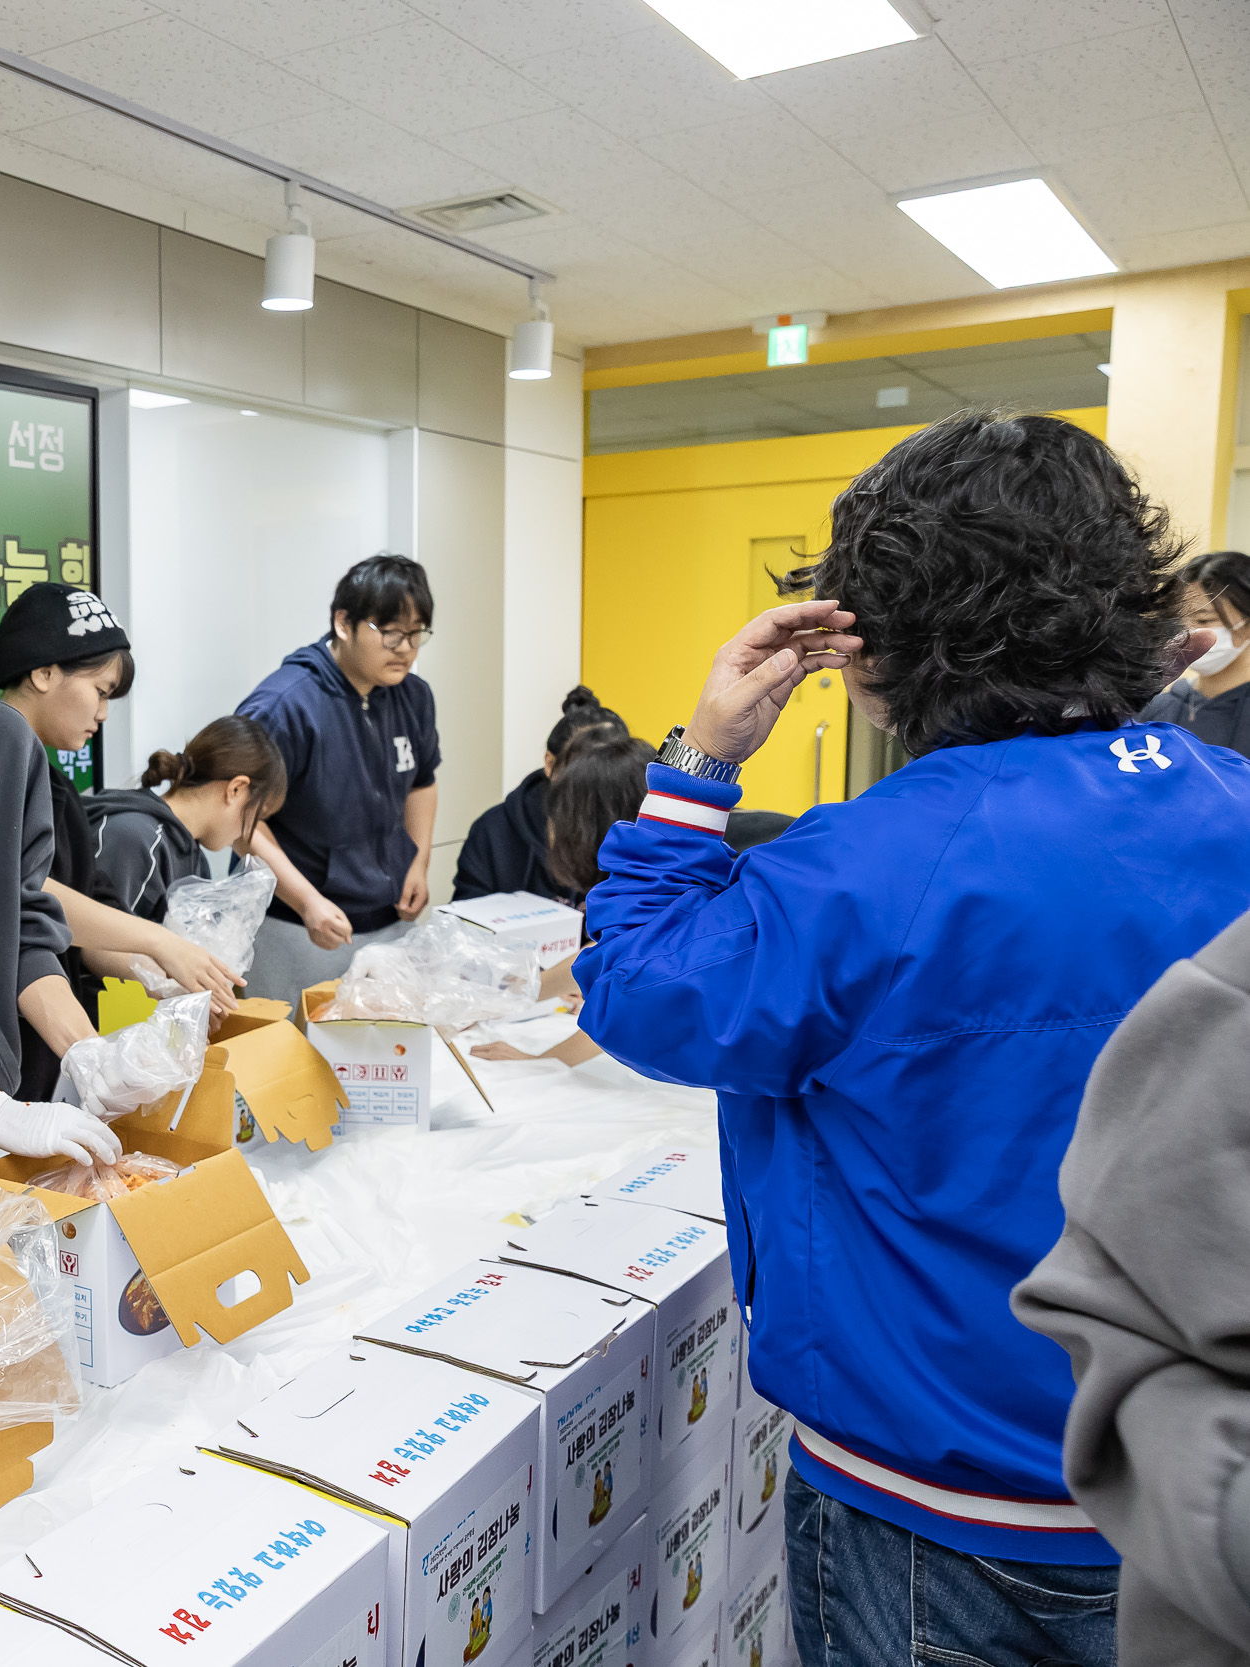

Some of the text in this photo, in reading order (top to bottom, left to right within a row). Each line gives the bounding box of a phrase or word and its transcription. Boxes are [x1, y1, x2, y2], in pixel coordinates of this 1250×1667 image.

[7, 419, 66, 473] 선정
[368, 1393, 490, 1487] 아삭하고 맛있는 김치
[565, 1422, 596, 1471] 사랑의
[598, 1389, 636, 1439] 김장나눔
[158, 1519, 327, 1646] 아삭하고 맛있는 김치
[436, 1544, 474, 1604] 사랑의
[477, 1502, 521, 1562] 김장나눔
